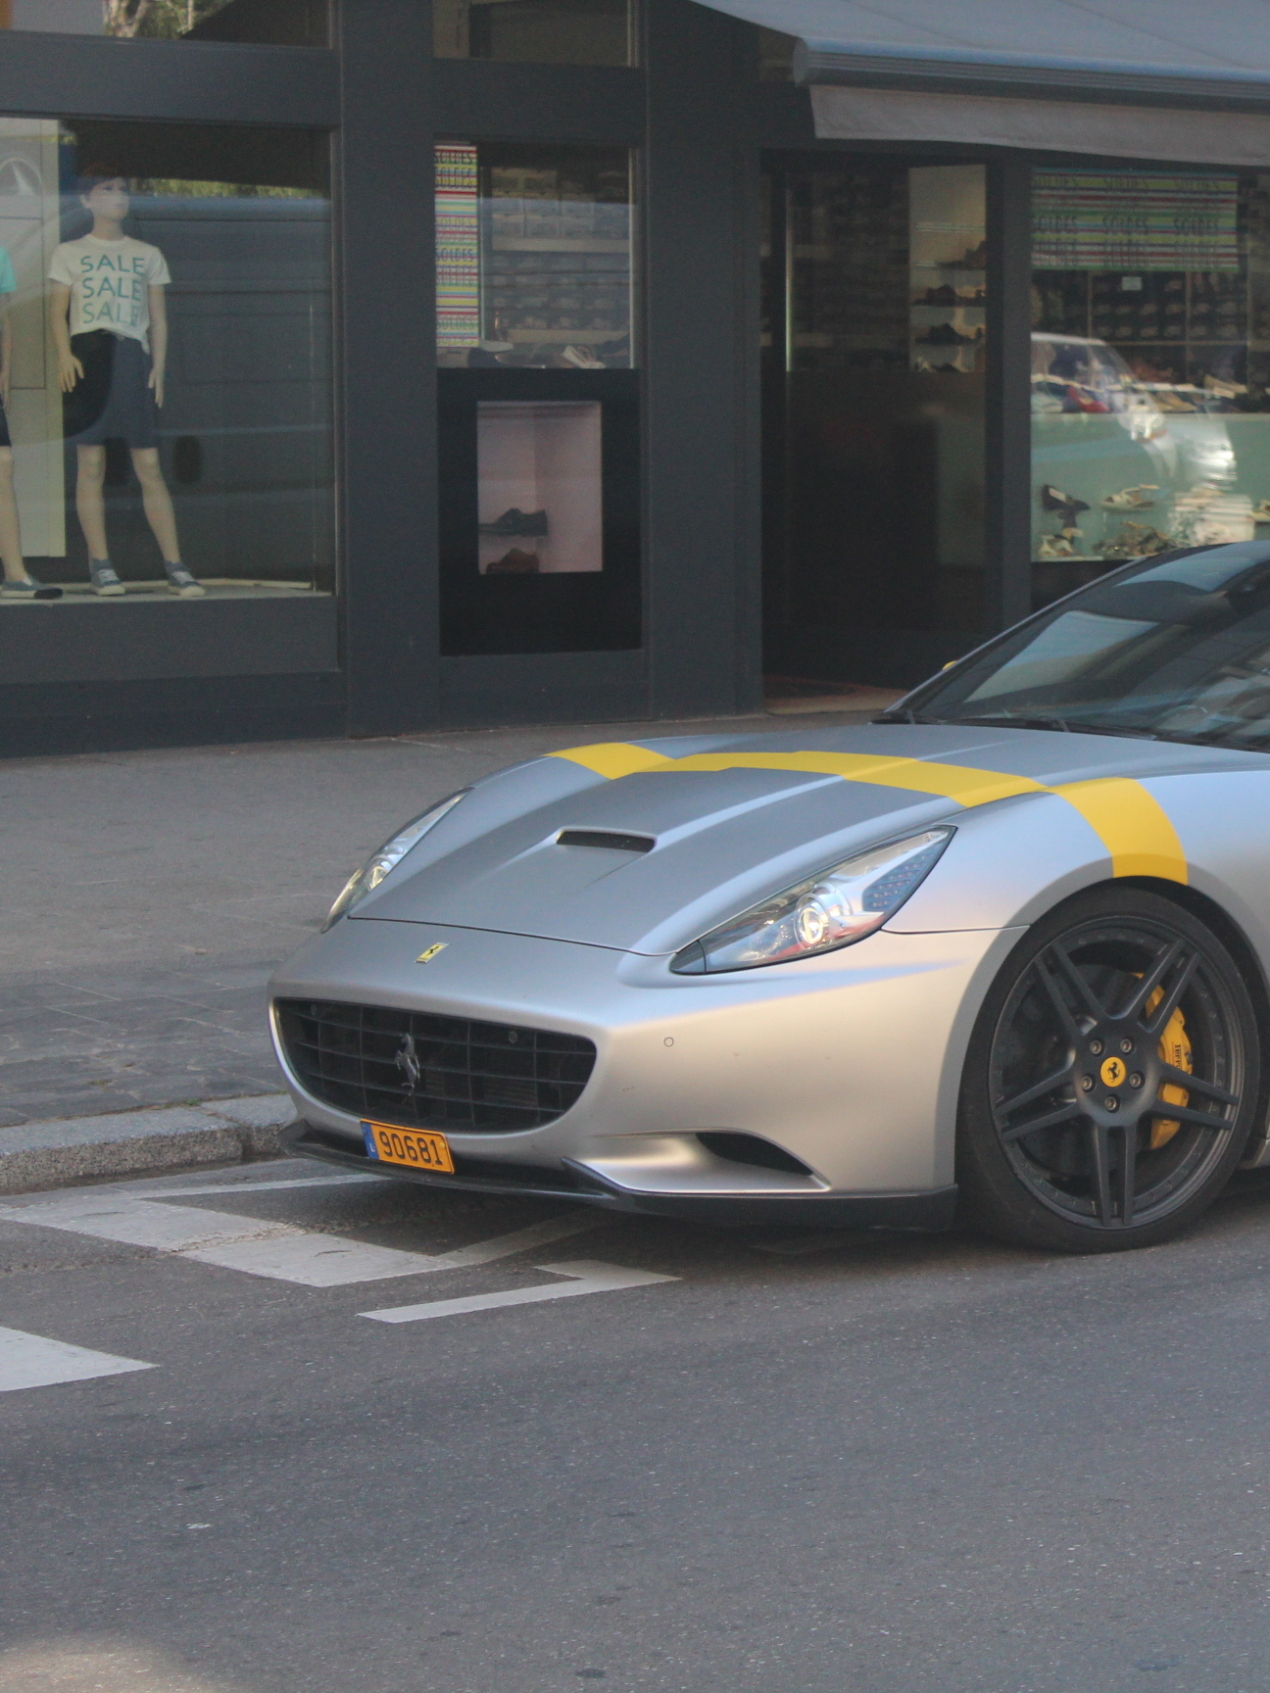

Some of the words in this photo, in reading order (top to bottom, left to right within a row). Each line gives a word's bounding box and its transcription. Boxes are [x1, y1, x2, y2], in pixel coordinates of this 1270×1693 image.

[80, 254, 146, 277] SALE
[82, 276, 142, 302] SALE
[82, 301, 139, 327] SALE
[368, 1142, 376, 1153] L
[378, 1130, 443, 1166] 90681
